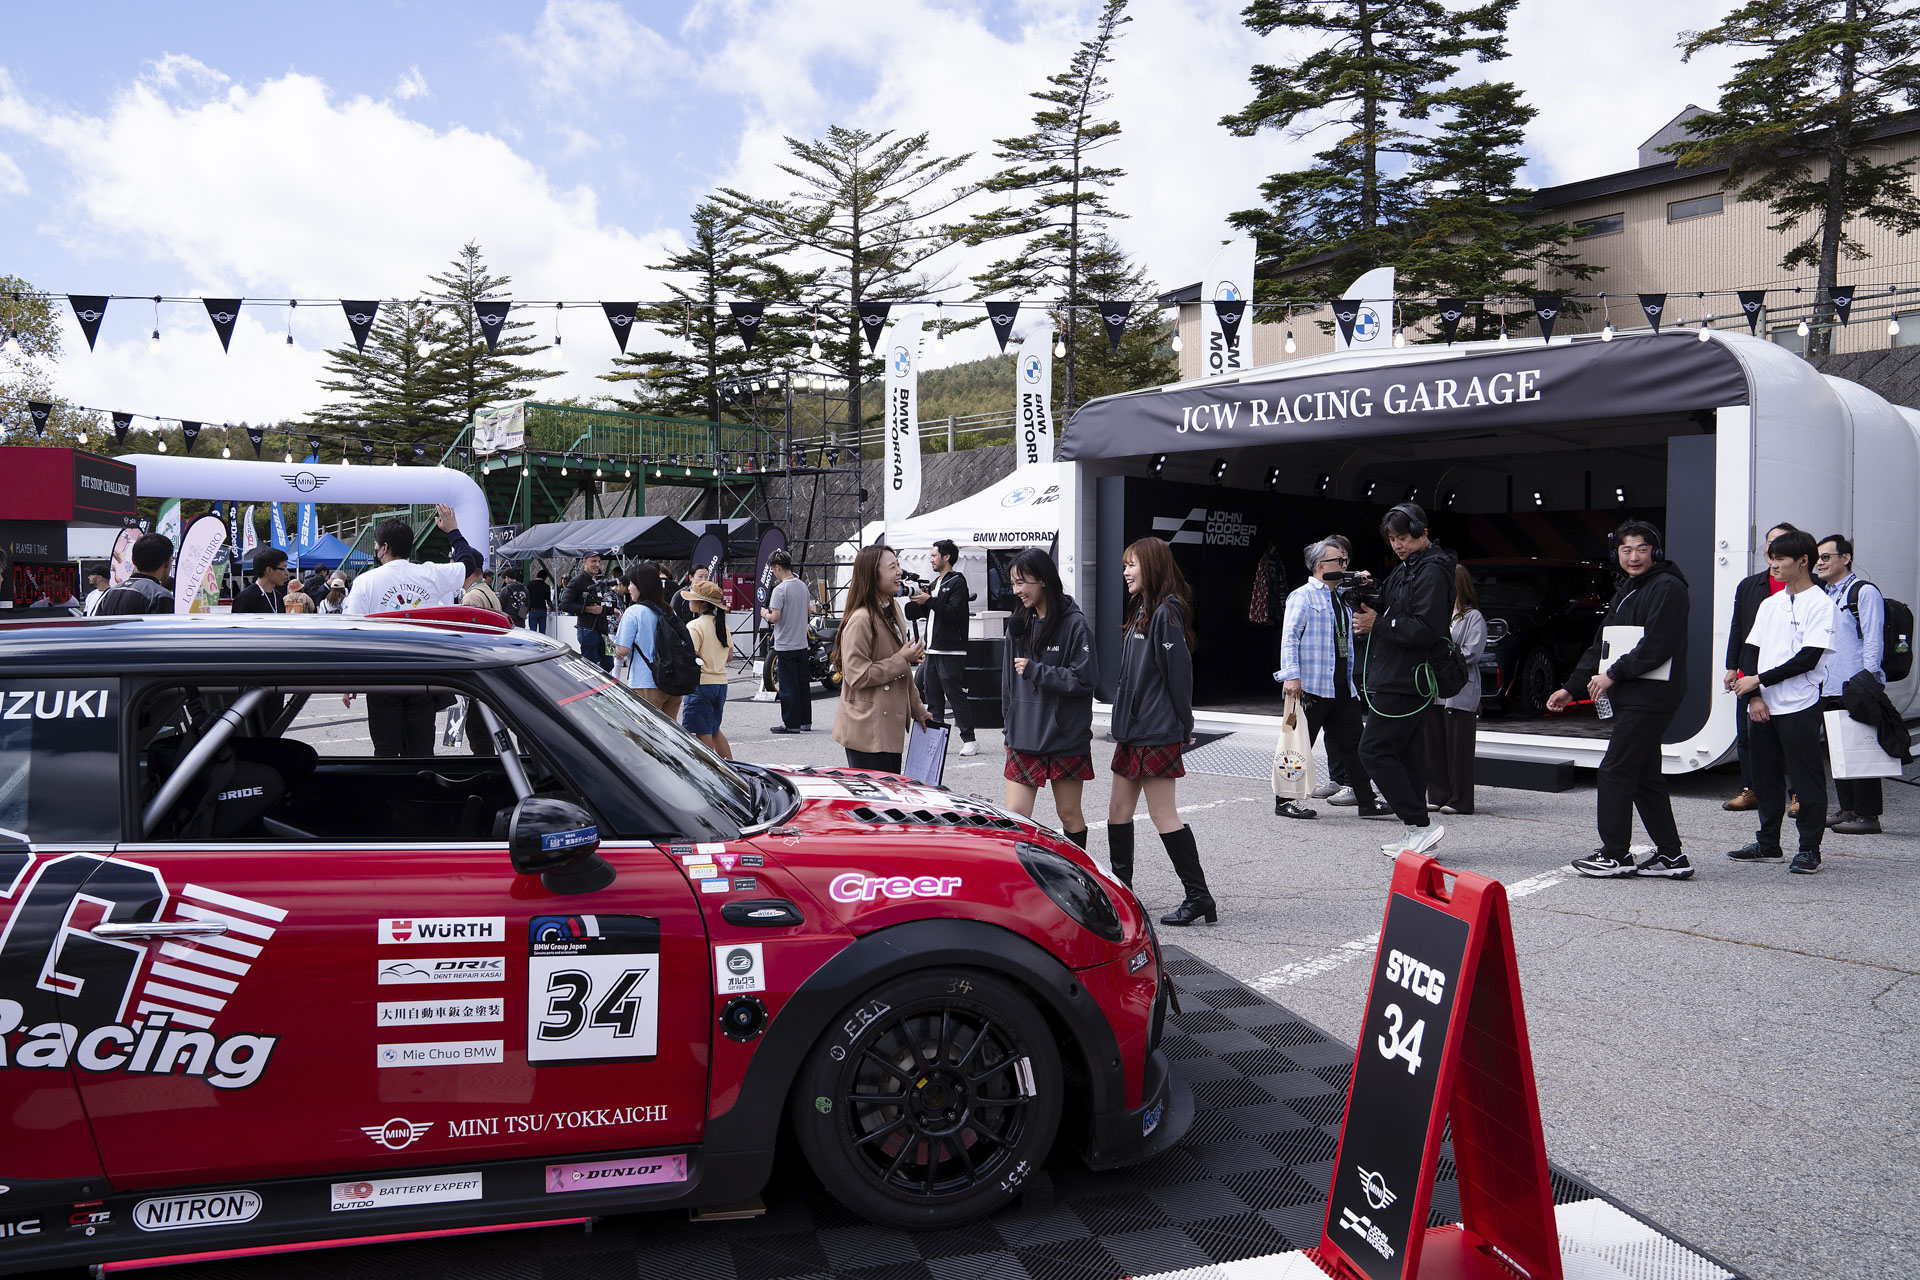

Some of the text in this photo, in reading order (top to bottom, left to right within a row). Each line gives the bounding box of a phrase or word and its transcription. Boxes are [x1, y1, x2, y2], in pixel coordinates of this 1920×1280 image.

[1176, 369, 1541, 434] JCW RACING GARAGE
[900, 388, 910, 436] BMW
[1035, 394, 1046, 436] BMW
[81, 475, 130, 496] PIT STOP CHALLENGE
[301, 504, 310, 546] TIRES
[1208, 511, 1242, 523] JOHN
[973, 532, 1054, 542] BMW MOTORRAD
[1206, 522, 1257, 536] COOPER
[16, 543, 33, 554] PLAYER
[37, 545, 48, 555] TIME
[1206, 534, 1250, 546] WORKS
[182, 575, 201, 604] LOVE
[197, 532, 222, 578] CHURRO
[380, 586, 398, 606] MINI
[0, 690, 108, 720] ZUKI
[217, 786, 263, 801] BRIDE
[829, 872, 962, 903] Creer
[434, 960, 502, 970] DRK
[1386, 949, 1446, 1006] SYCG
[381, 1004, 500, 1020] 大川自動車鈑金塗装
[536, 968, 650, 1041] 34
[1378, 1003, 1425, 1076] 34
[403, 1046, 496, 1060] Mie Chuo BMW
[385, 1104, 668, 1140] MINI MINI TSU/YOKKAICHI
[586, 1165, 663, 1179] DUNLOP
[379, 1181, 479, 1196] BATTERY EXPERT
[1369, 1182, 1383, 1200] MINI
[333, 1200, 374, 1209] OUTDO
[1368, 1229, 1395, 1257] COOPER
[1370, 1225, 1389, 1242] JOHN
[1366, 1234, 1390, 1260] WORKS
